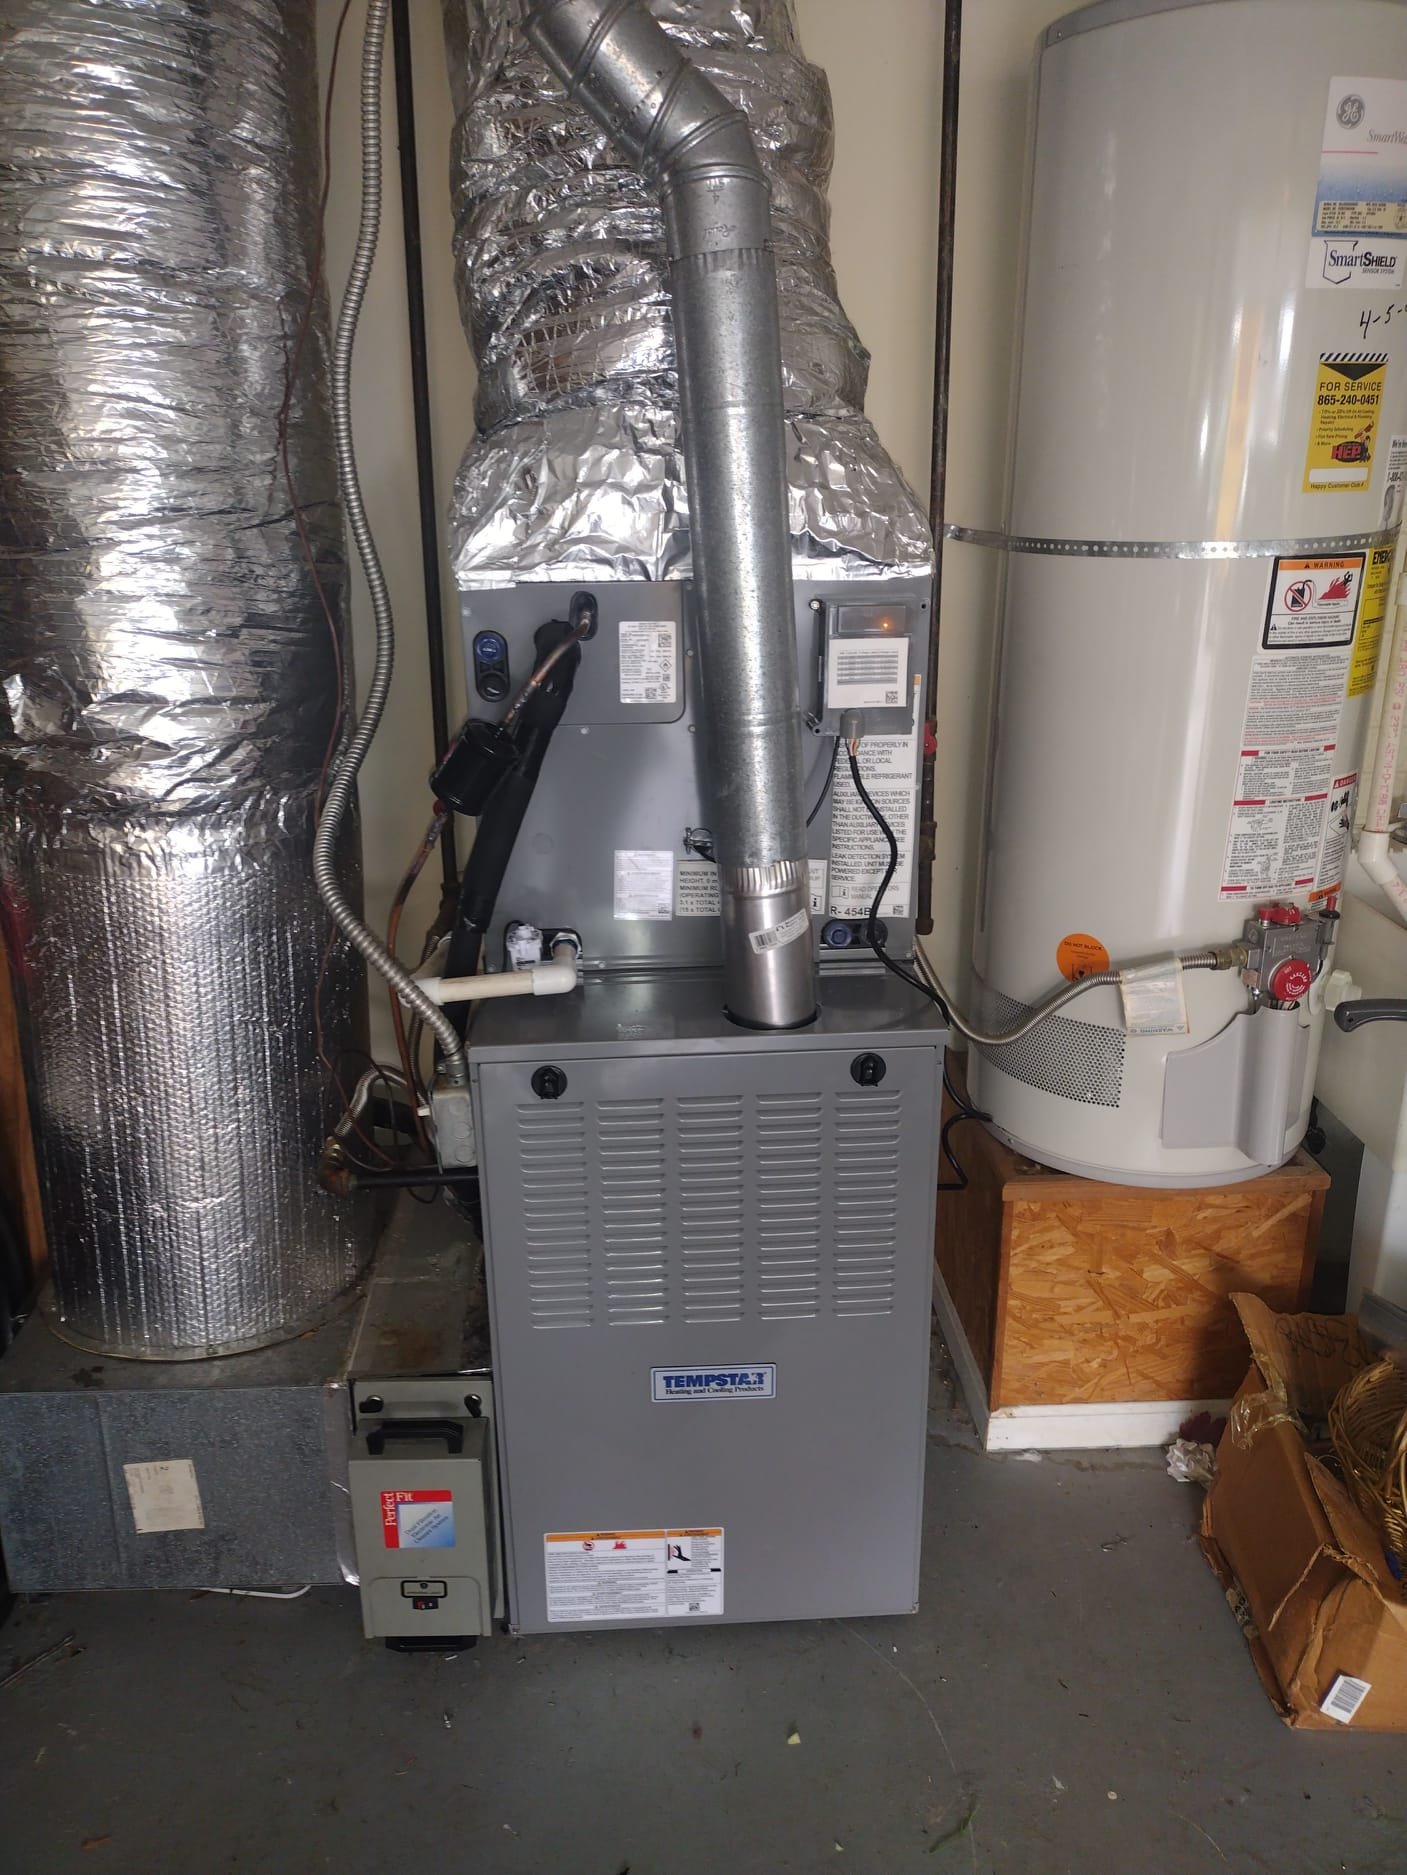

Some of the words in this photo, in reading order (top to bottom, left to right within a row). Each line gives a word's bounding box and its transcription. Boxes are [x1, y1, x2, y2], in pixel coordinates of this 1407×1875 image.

[1328, 249, 1397, 268] SmartSHIELD
[1319, 381, 1341, 392] FOR
[1343, 381, 1382, 392] SERVICE
[1317, 393, 1379, 406] 865-240-0451
[1313, 561, 1345, 569] WARNING
[663, 1373, 765, 1388] TEMPSTAR
[665, 1387, 692, 1395] Heating
[693, 1386, 706, 1394] and
[707, 1385, 734, 1394] Cooling
[734, 1384, 764, 1392] Products
[396, 1492, 414, 1502] Fit
[383, 1492, 397, 1527] Perfect
